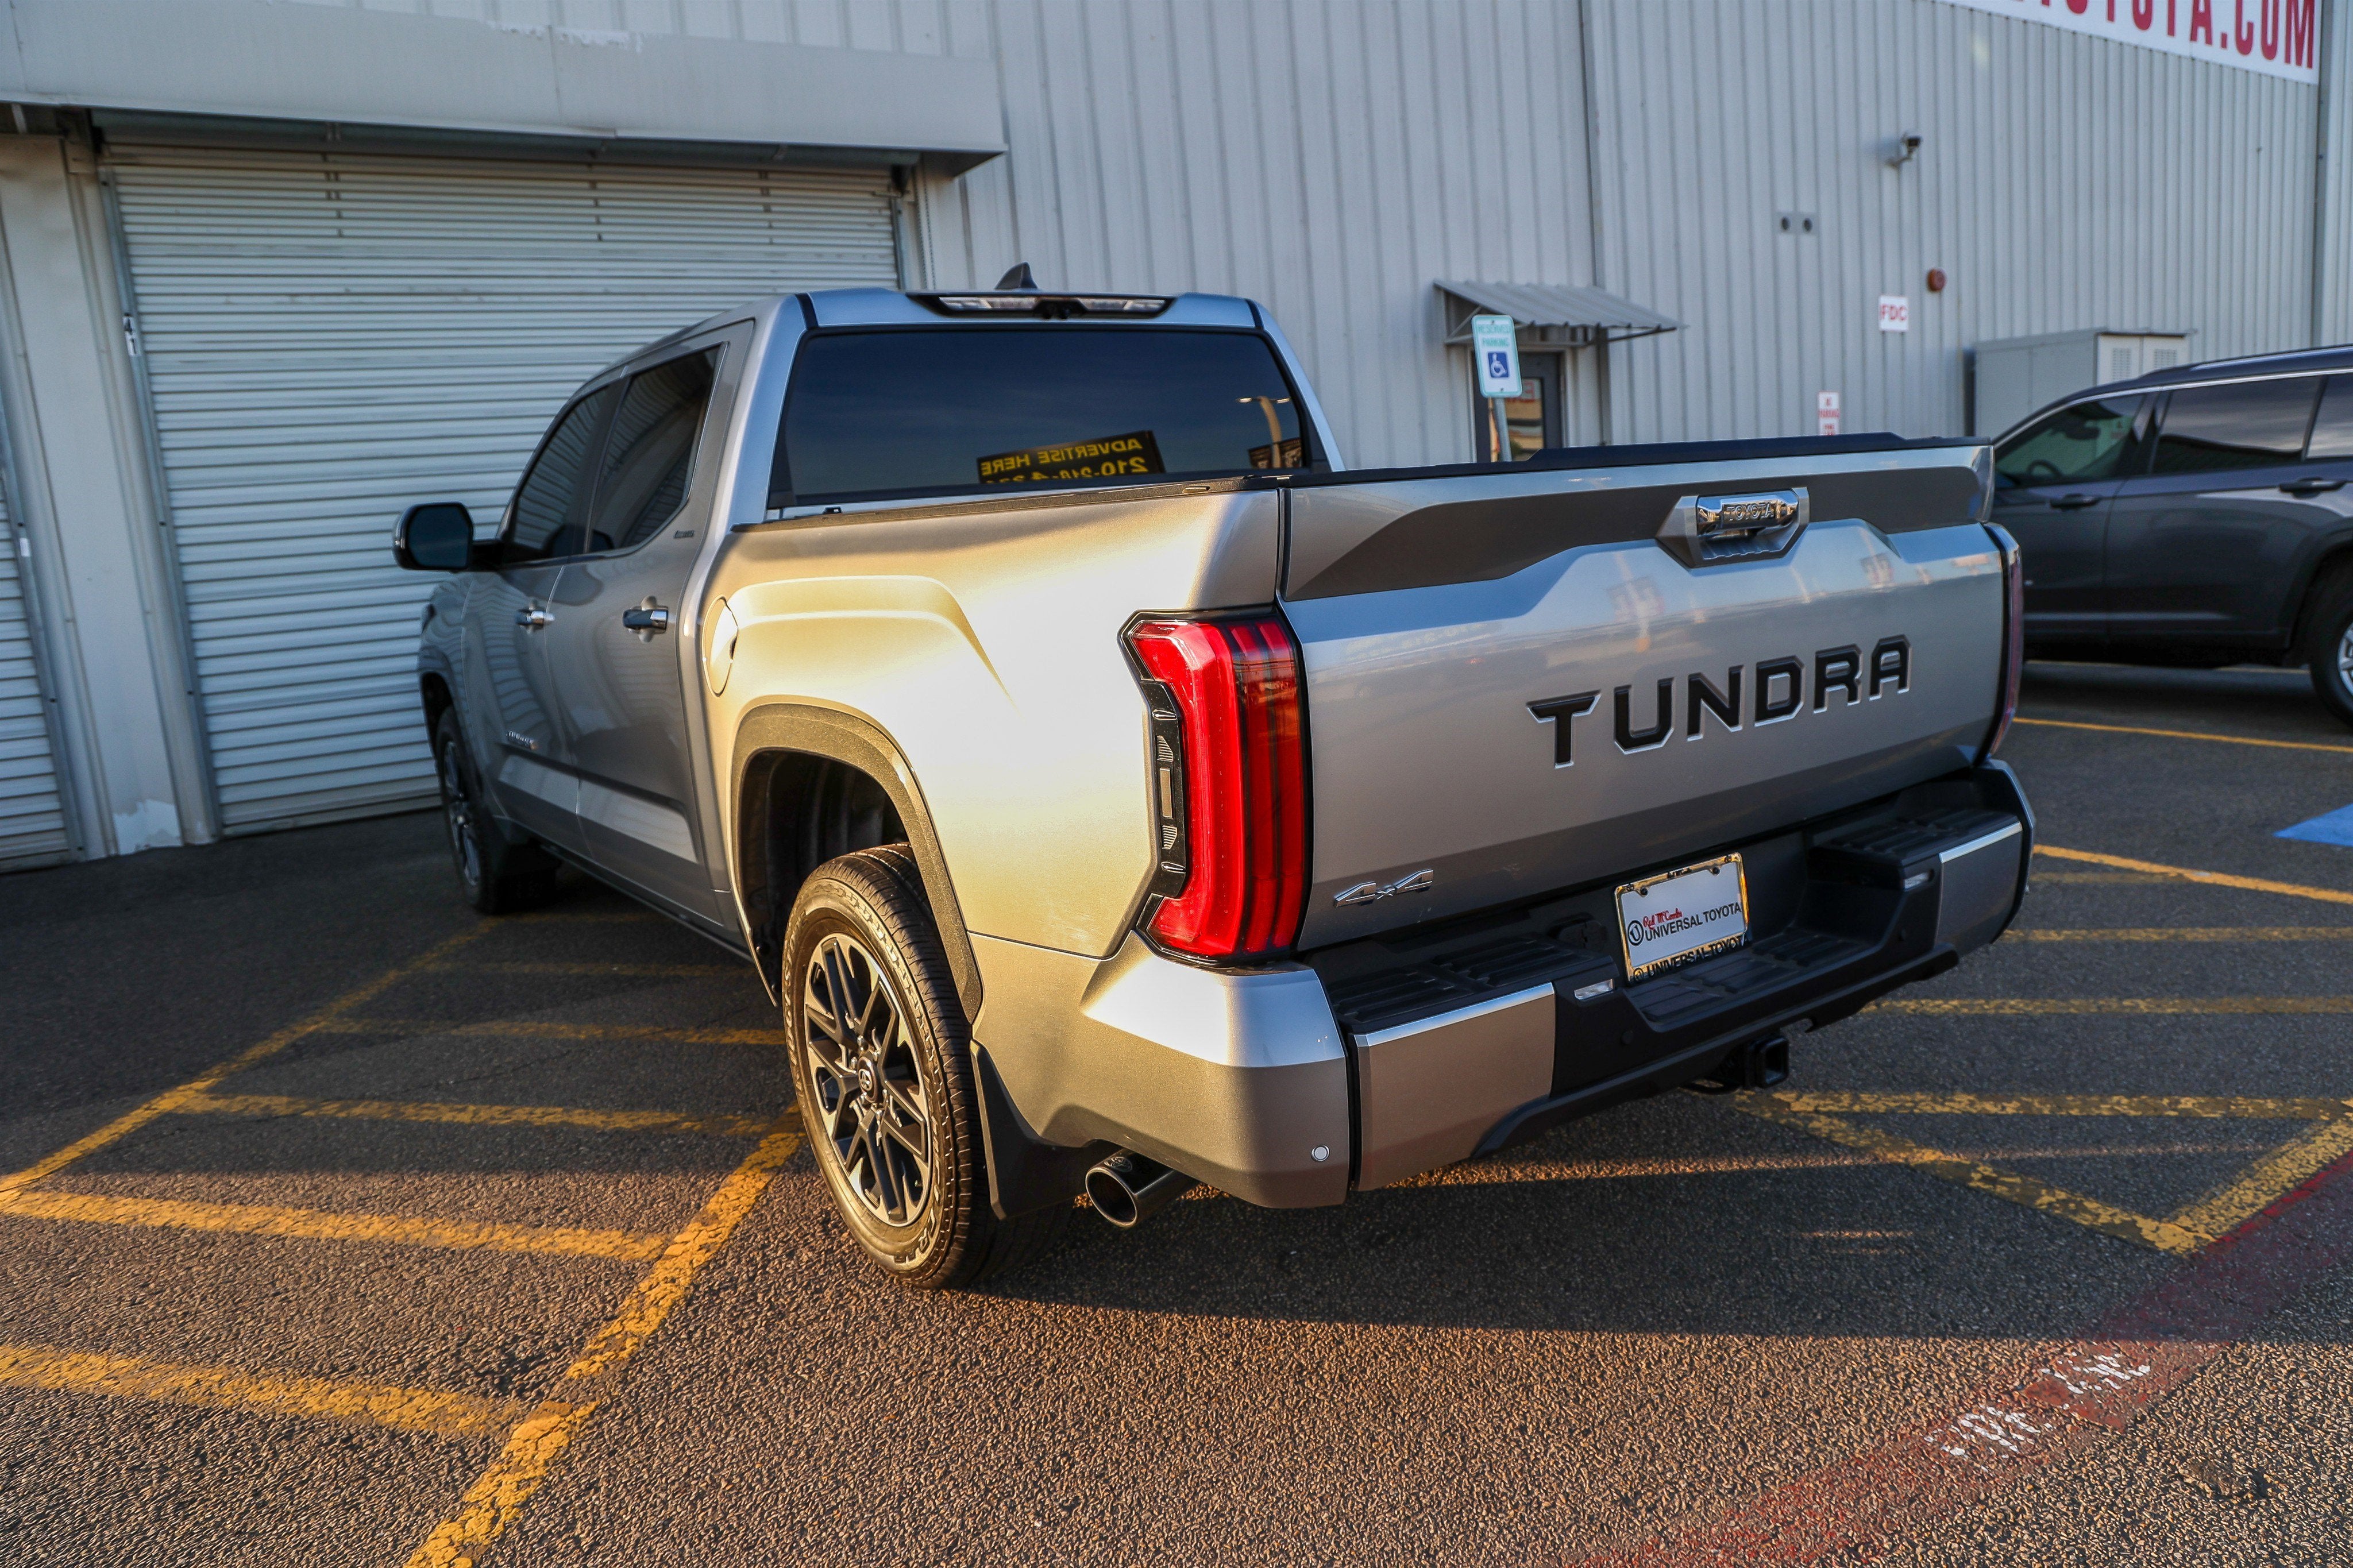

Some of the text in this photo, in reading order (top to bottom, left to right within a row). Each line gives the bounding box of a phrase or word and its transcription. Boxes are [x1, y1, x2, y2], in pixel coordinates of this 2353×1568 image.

[1880, 303, 1908, 322] FDC
[1726, 501, 1775, 522] TOYOTA
[1526, 634, 1912, 770] TUNDRA
[1334, 868, 1434, 909] 4x4
[1644, 914, 1703, 942] UNIVERSAL
[1702, 902, 1742, 923] TOYOTA
[1646, 947, 1709, 977] UNIVERSAL
